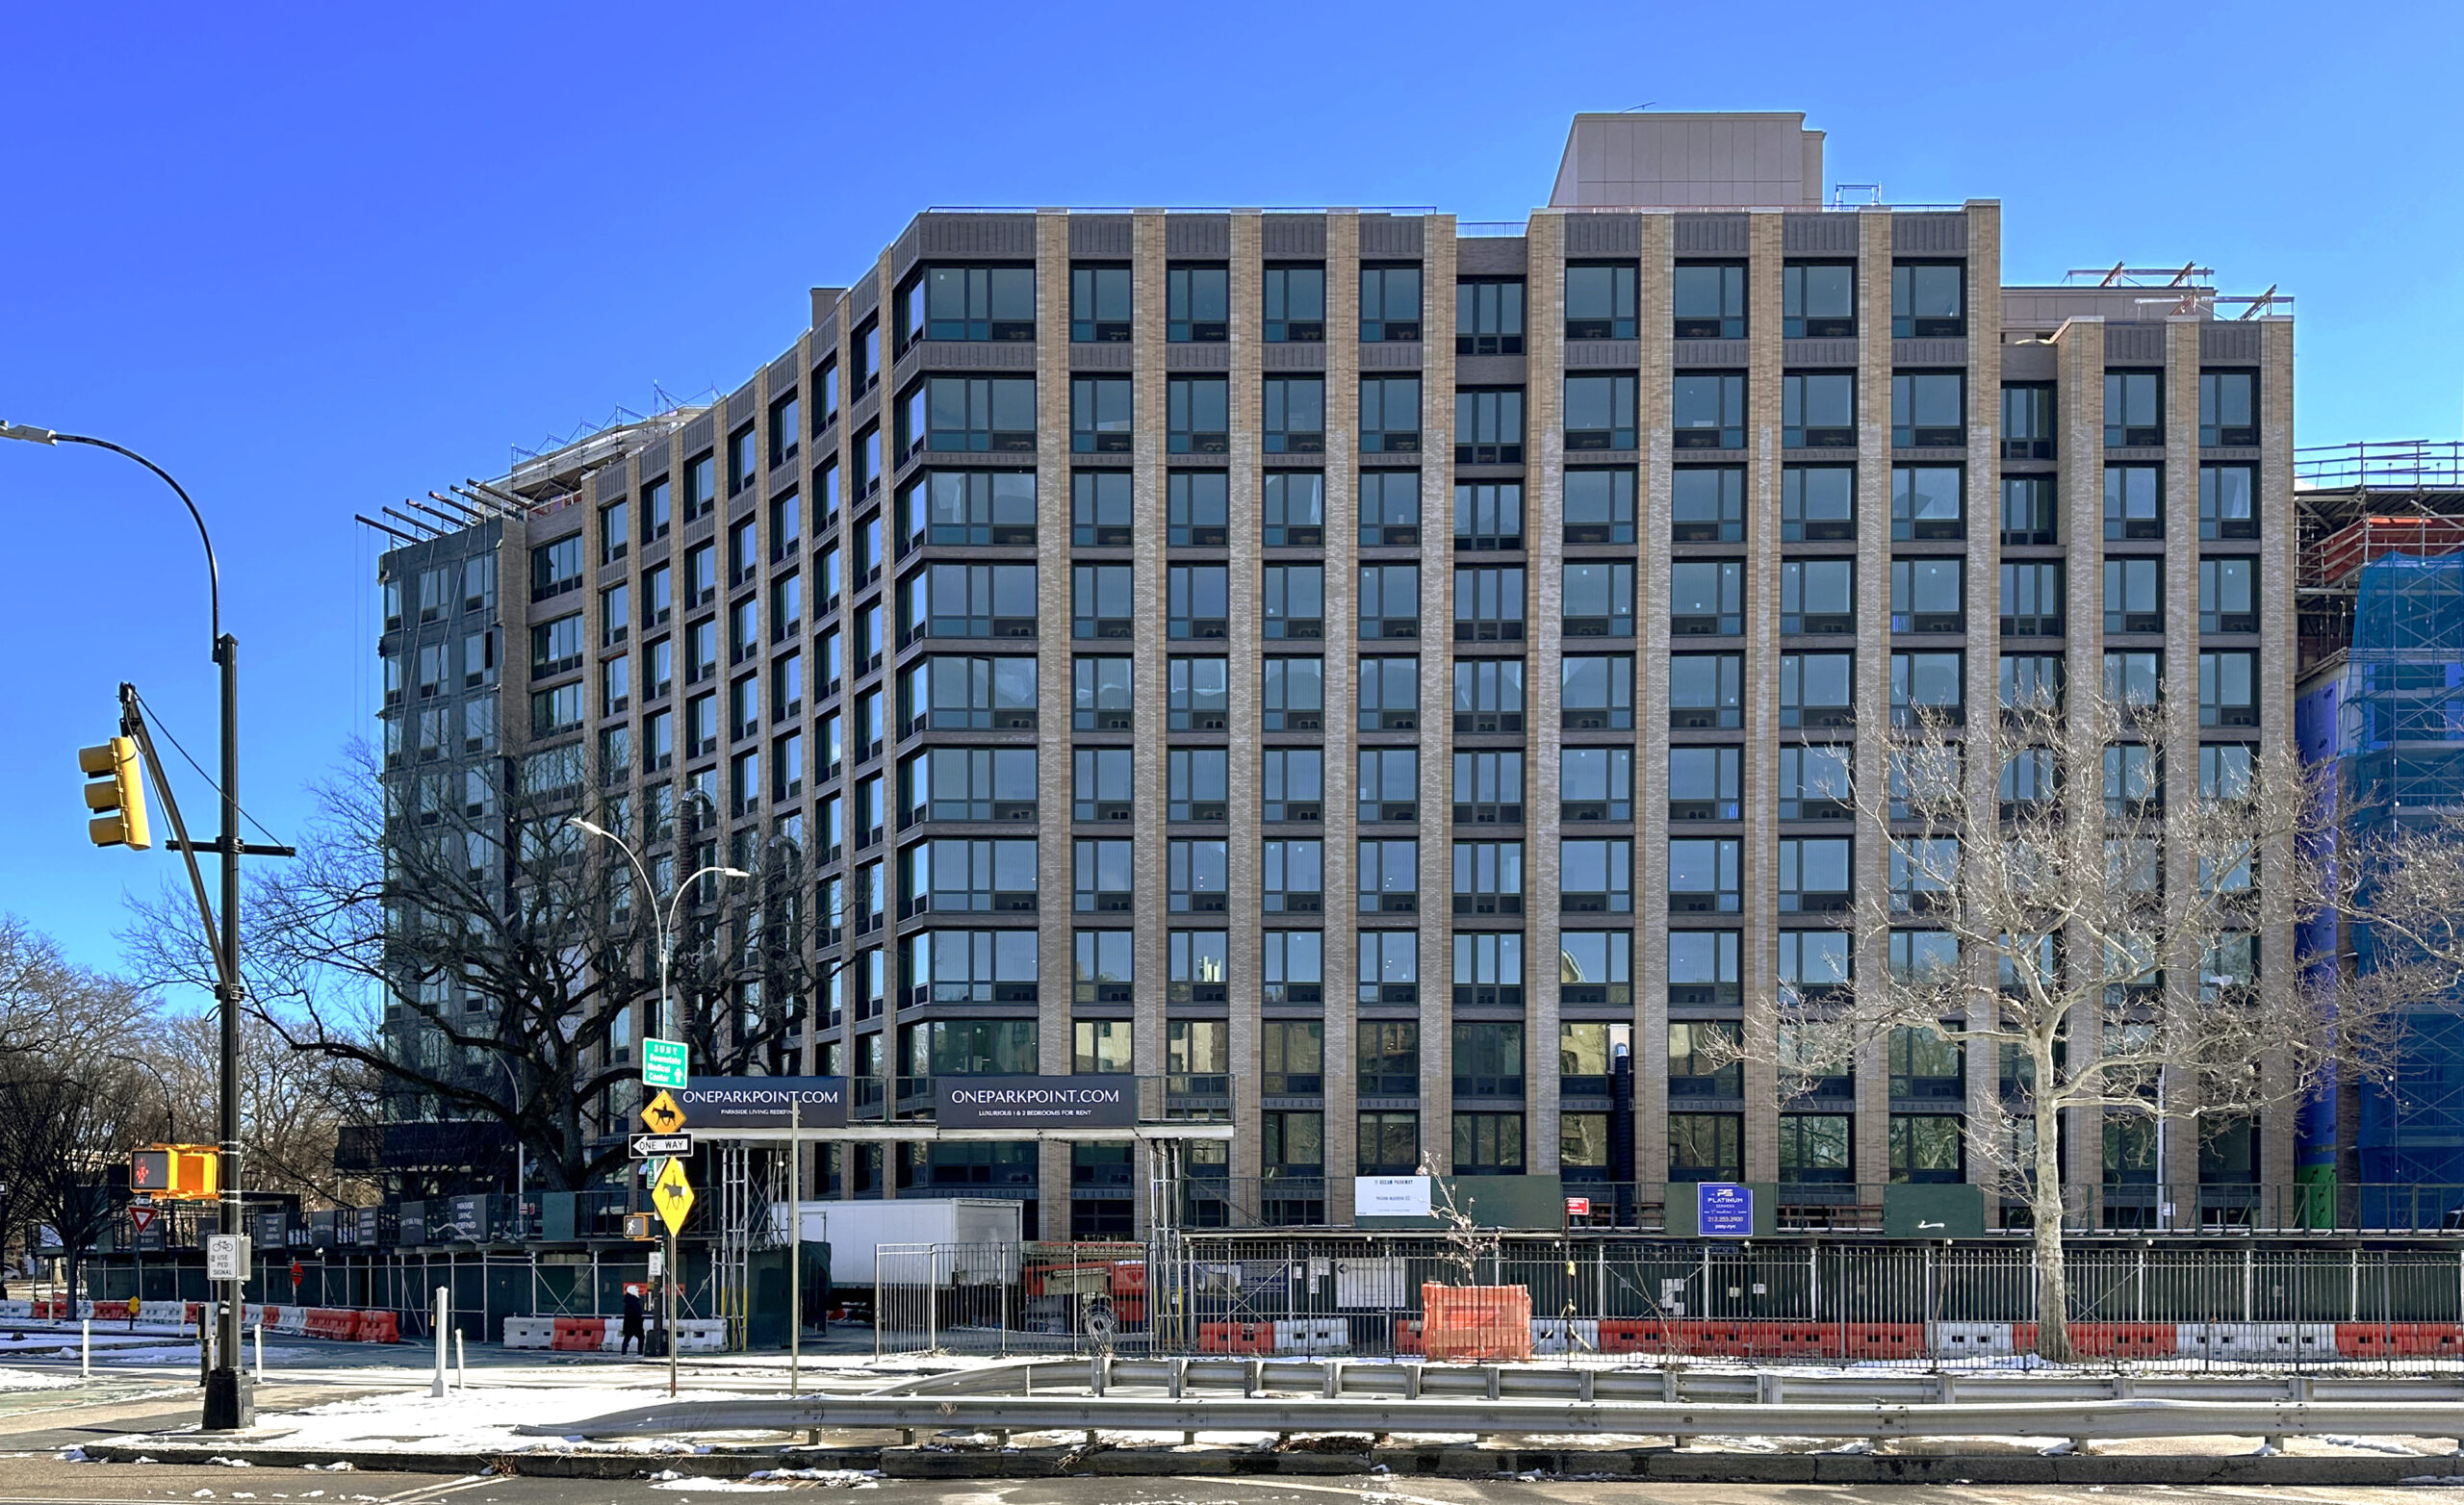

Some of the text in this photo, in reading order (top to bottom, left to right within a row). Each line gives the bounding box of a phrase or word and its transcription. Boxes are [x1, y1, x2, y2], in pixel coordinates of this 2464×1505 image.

[654, 1044, 678, 1056] SUNY
[682, 1090, 838, 1104] ONEPARKPOINT.COM
[951, 1089, 1119, 1104] ONEPARKPOINT.COM
[639, 1140, 684, 1151] ONE WAY
